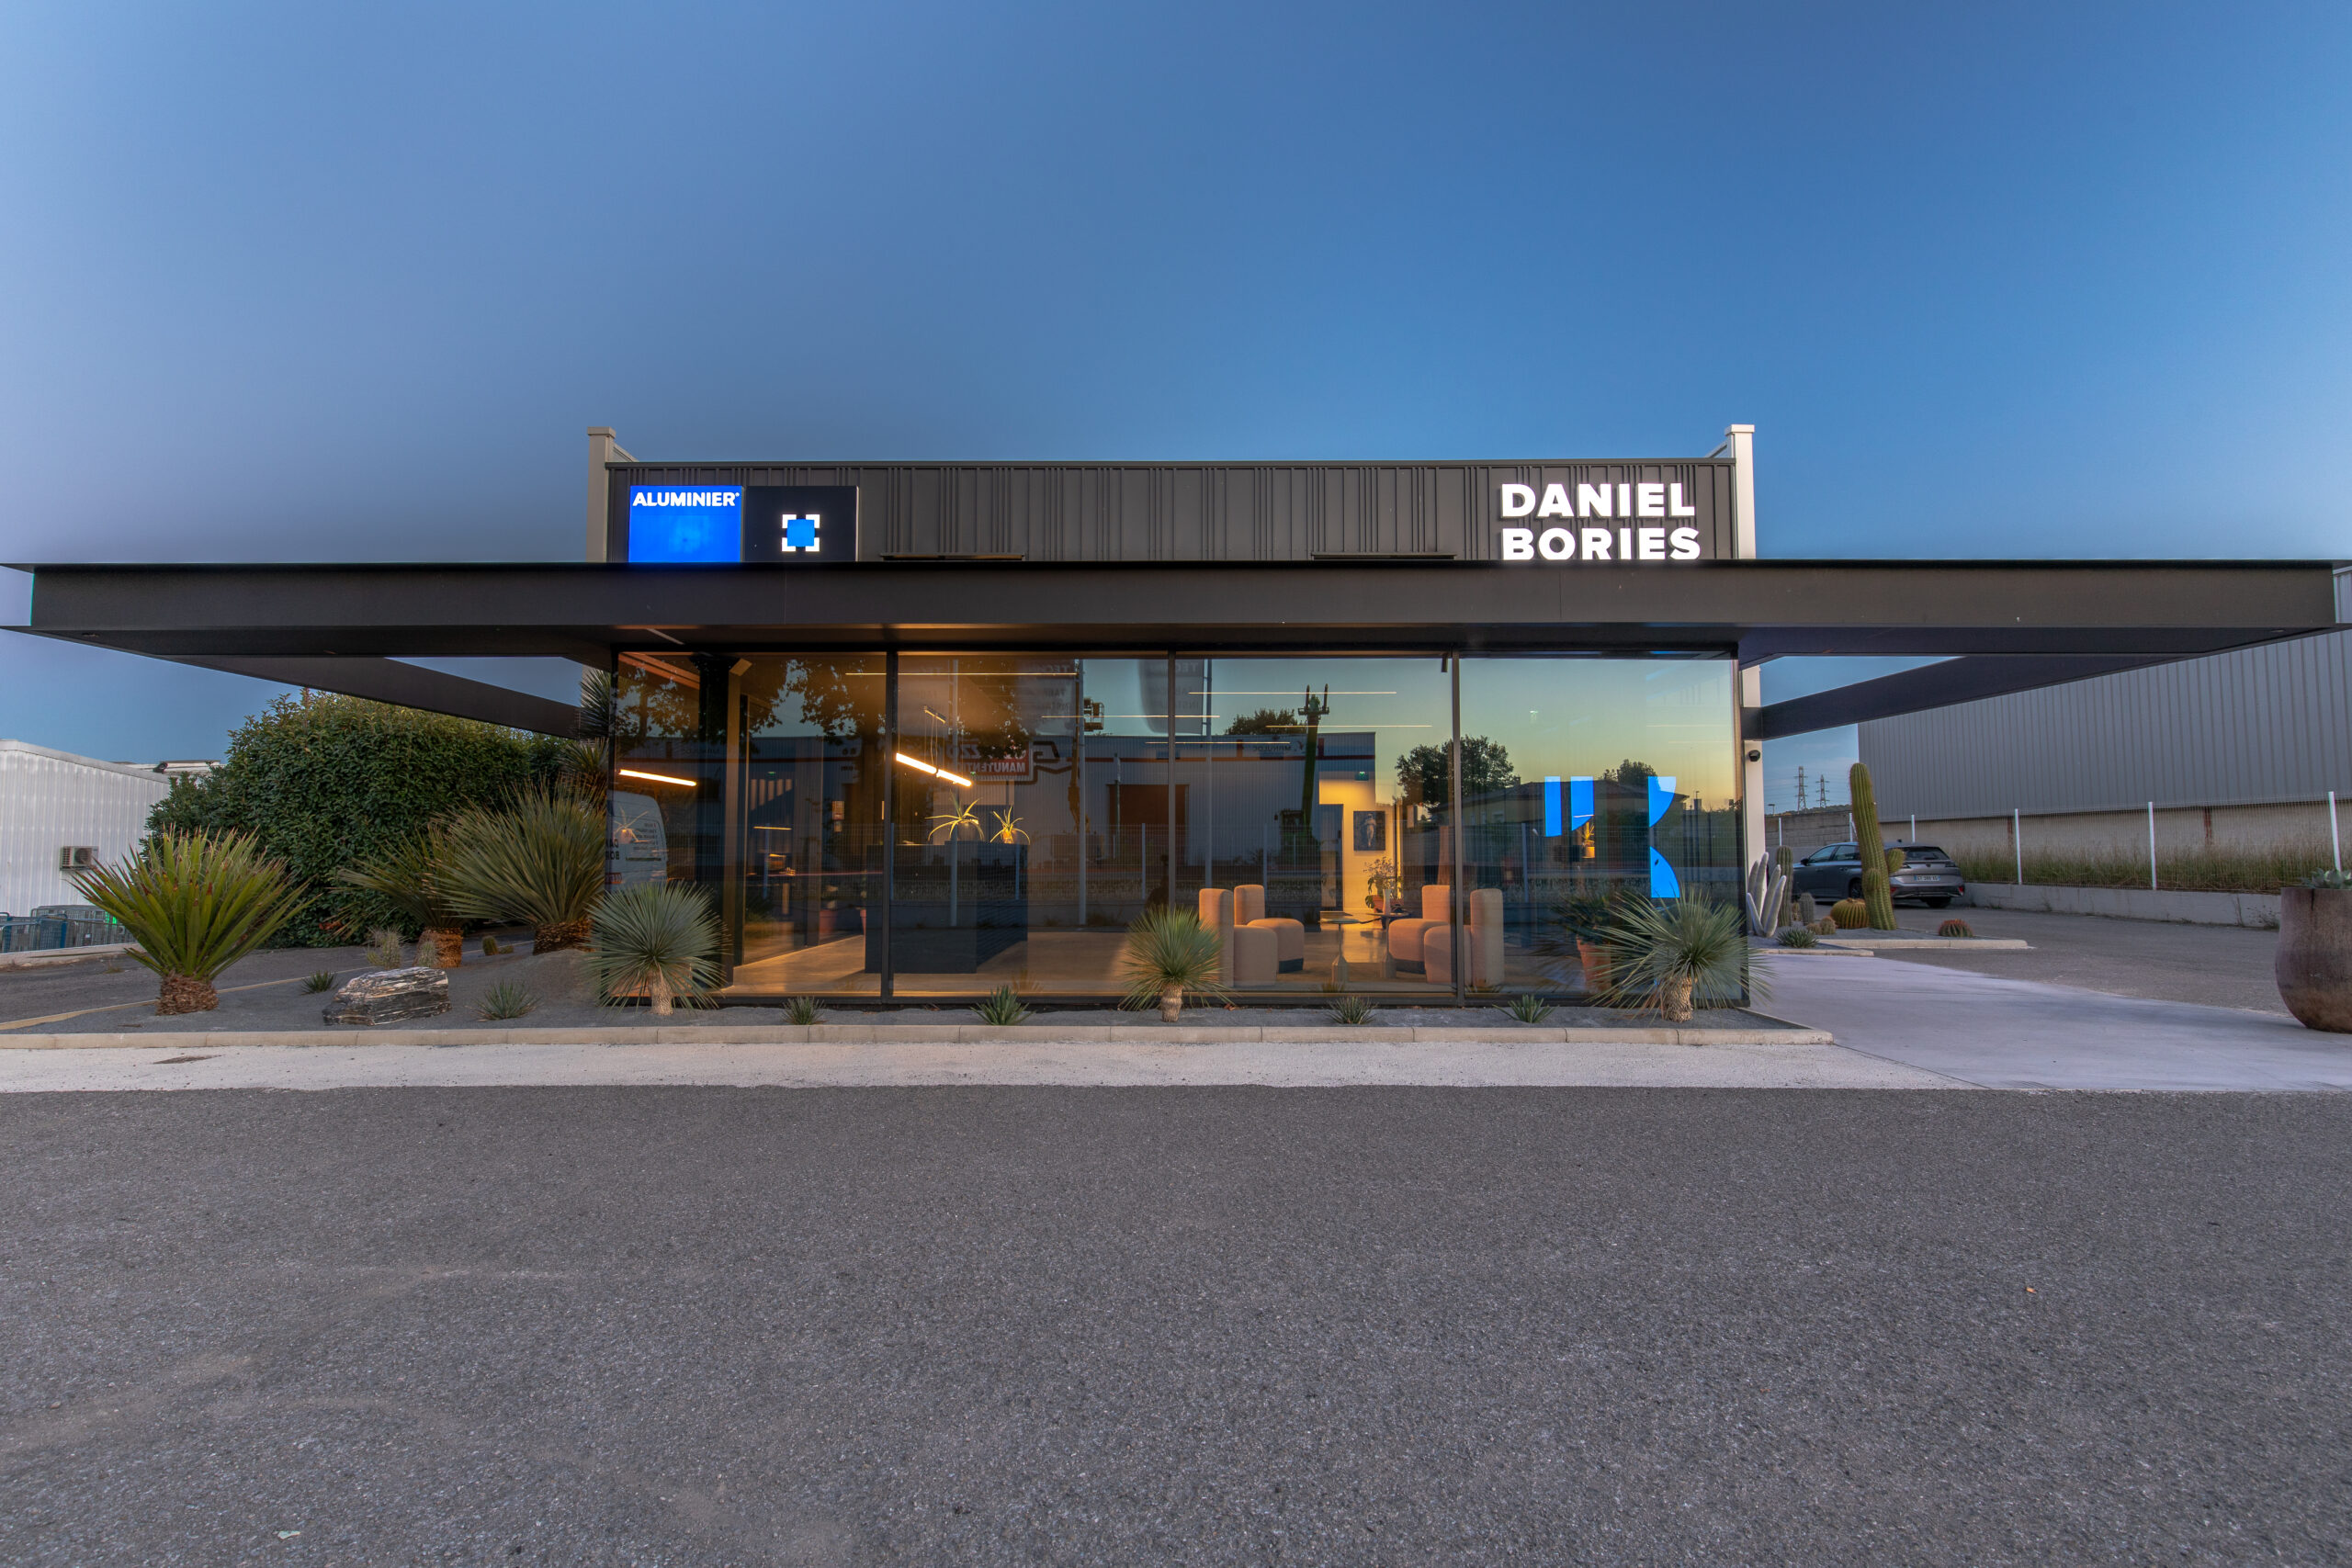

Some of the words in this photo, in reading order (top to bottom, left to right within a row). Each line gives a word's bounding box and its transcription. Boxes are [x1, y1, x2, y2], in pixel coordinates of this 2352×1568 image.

[632, 491, 739, 507] ALUMINIER
[1500, 482, 1696, 518] DANIEL
[1501, 526, 1701, 560] BORIES
